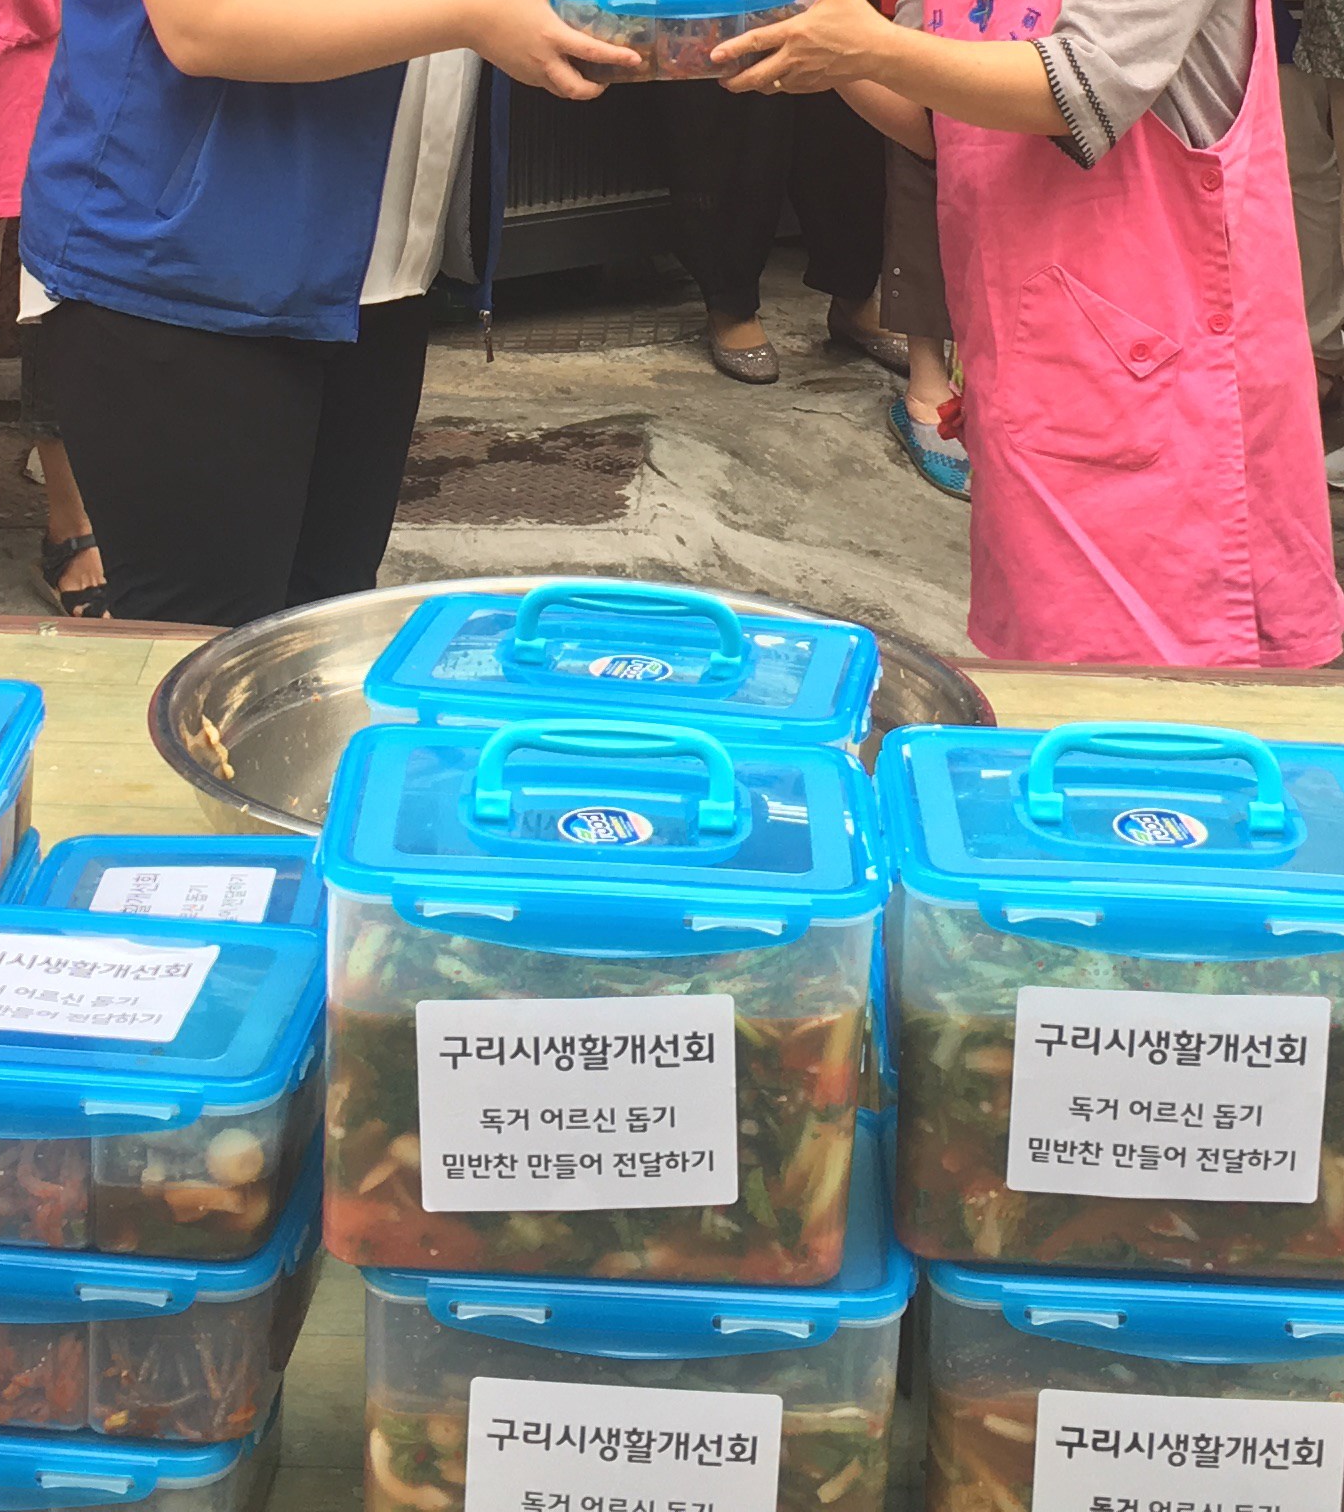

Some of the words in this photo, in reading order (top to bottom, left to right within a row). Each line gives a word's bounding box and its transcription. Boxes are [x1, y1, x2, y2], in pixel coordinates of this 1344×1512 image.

[439, 1031, 716, 1072] 구리시생활개선회
[1034, 1022, 1308, 1069] 구리시생활개선회
[479, 1108, 531, 1135] 독거
[539, 1107, 617, 1134] 어르신
[625, 1105, 677, 1134] 돕기
[1068, 1095, 1119, 1123] 독거
[1128, 1099, 1205, 1129] 어르신
[1212, 1103, 1264, 1130] 돕기
[441, 1152, 519, 1180] 밑반찬
[527, 1152, 604, 1180] 만들어
[612, 1149, 716, 1179] 전달하기
[1027, 1136, 1104, 1167] 밑반찬
[1111, 1142, 1188, 1171] 만들어
[1195, 1146, 1297, 1174] 전달하기
[486, 1417, 760, 1467] 구리시생활개선회
[1055, 1424, 1325, 1471] 구리시생활개선회
